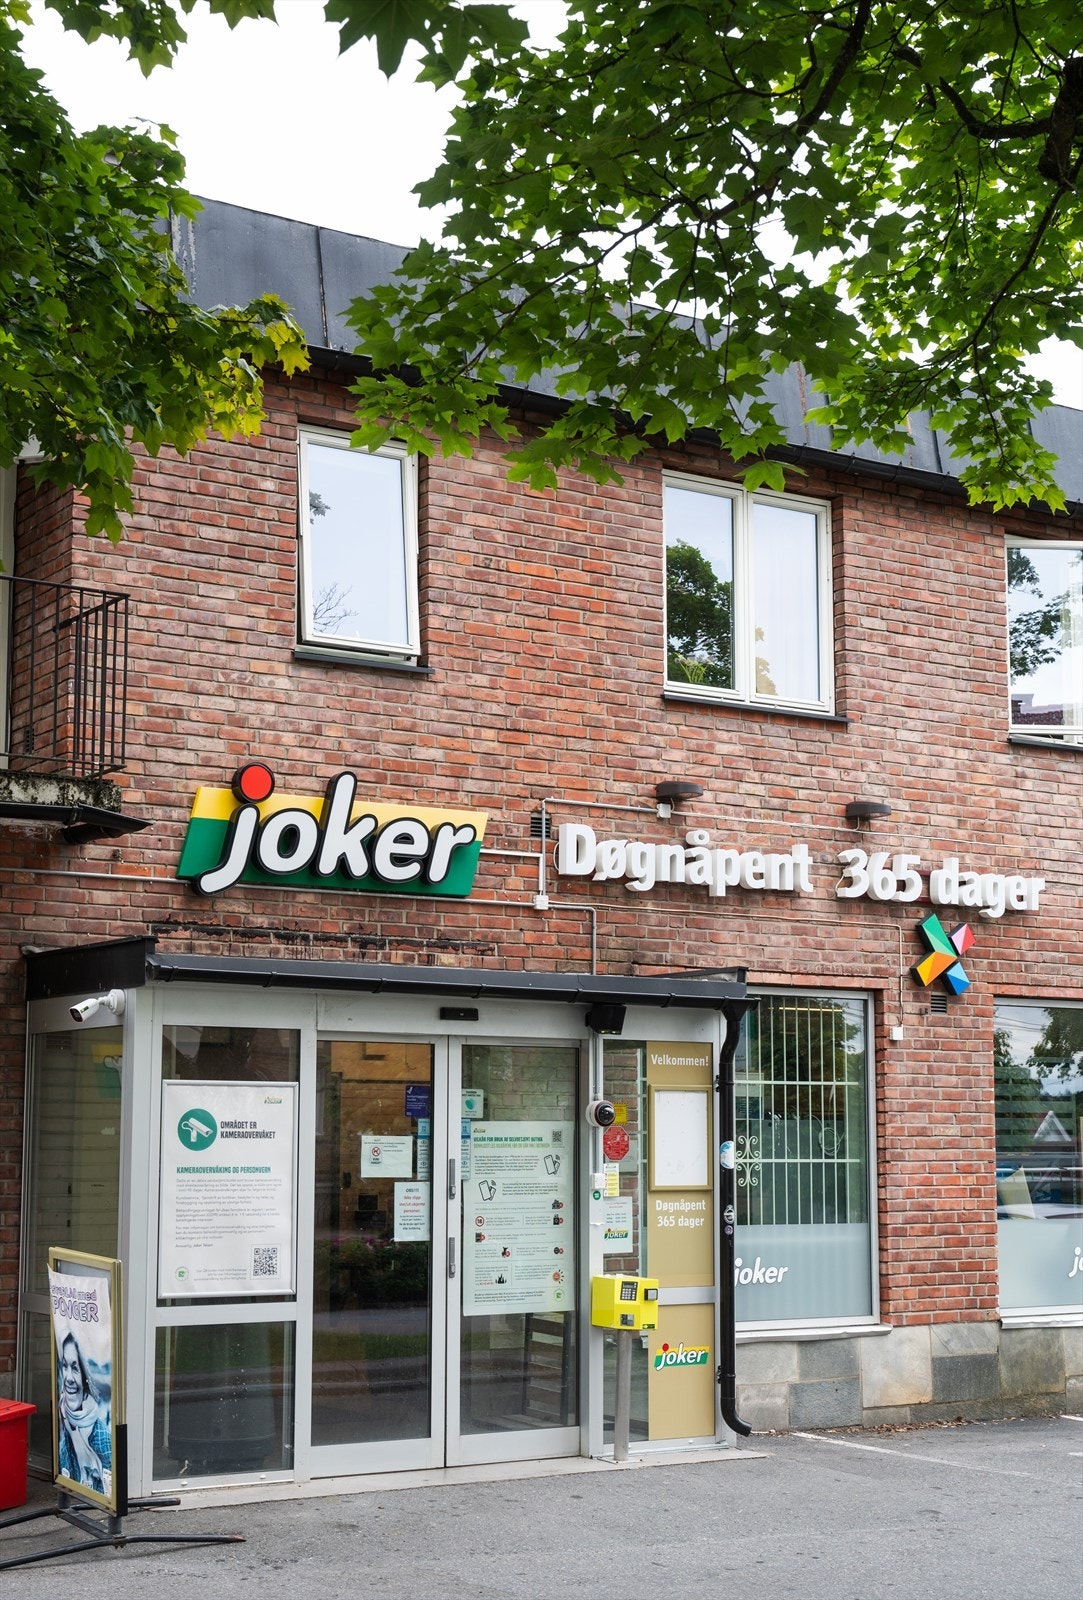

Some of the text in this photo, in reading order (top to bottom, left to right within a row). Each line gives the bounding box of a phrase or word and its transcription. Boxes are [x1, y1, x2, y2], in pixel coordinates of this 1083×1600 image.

[194, 762, 477, 896] joker
[557, 822, 1046, 919] Døgnåpent 365 dager
[651, 1054, 709, 1066] Velkommen!
[220, 1119, 257, 1129] OMRÅDET ER
[220, 1129, 276, 1139] KAMERAOVERVÅKET
[176, 1165, 271, 1174] KAMERAOVERVÅKING OG PERSONVERN
[655, 1198, 706, 1213] Døgnåpent
[657, 1215, 705, 1229] 365 dager
[604, 1228, 629, 1240] joker
[656, 1342, 706, 1371] joker
